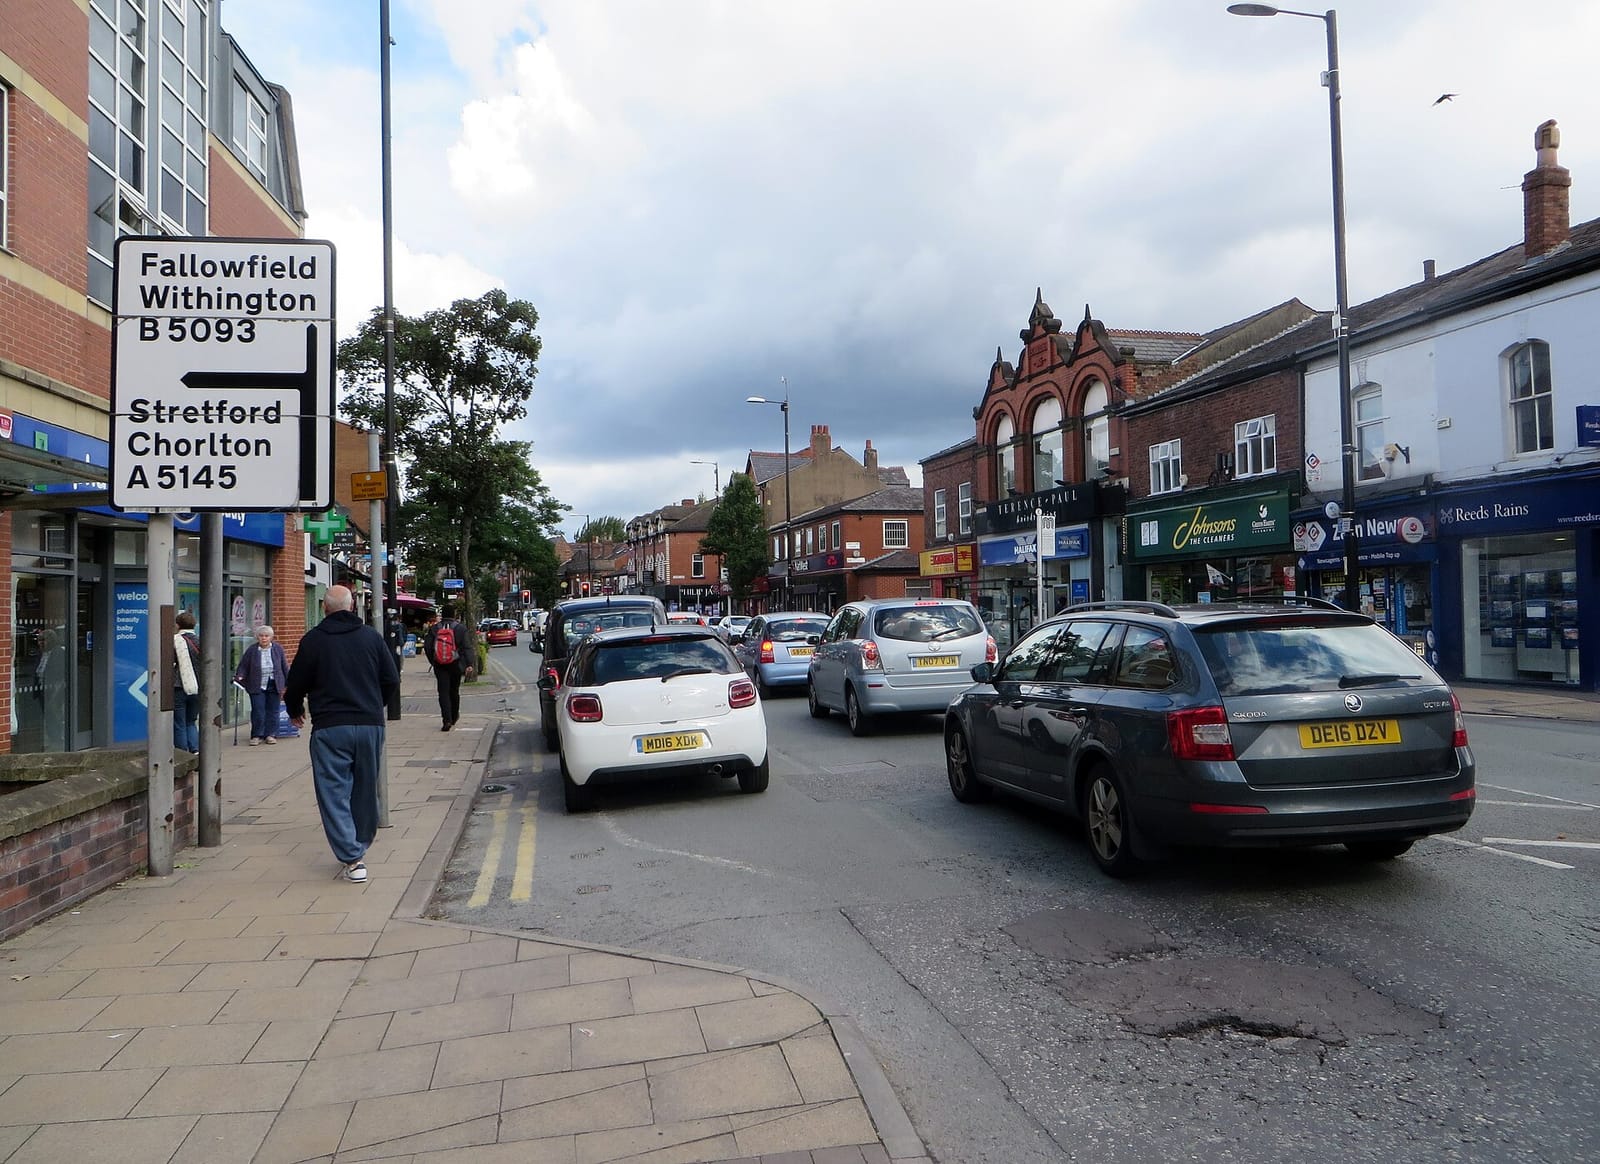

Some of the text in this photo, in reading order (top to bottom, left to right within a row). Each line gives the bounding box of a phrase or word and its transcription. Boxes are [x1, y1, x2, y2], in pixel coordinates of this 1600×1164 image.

[141, 253, 316, 279] Fallowfield
[140, 285, 316, 315] Withington
[139, 317, 256, 343] B 5093
[128, 399, 281, 424] Stretford
[128, 432, 271, 456] Chorlton
[127, 465, 237, 489] A 5145
[998, 489, 1078, 515] TERENCE PAUL
[1455, 503, 1529, 521] Reeds Rains
[1172, 506, 1237, 550] Johnsons
[1203, 534, 1234, 544] CLEANERS
[1366, 518, 1402, 537] New
[1014, 544, 1037, 555] HALIFAX
[117, 625, 134, 633] baby
[117, 633, 137, 641] photo
[646, 735, 699, 750] MD16 XDK
[1310, 722, 1387, 744] DE16 DZV
